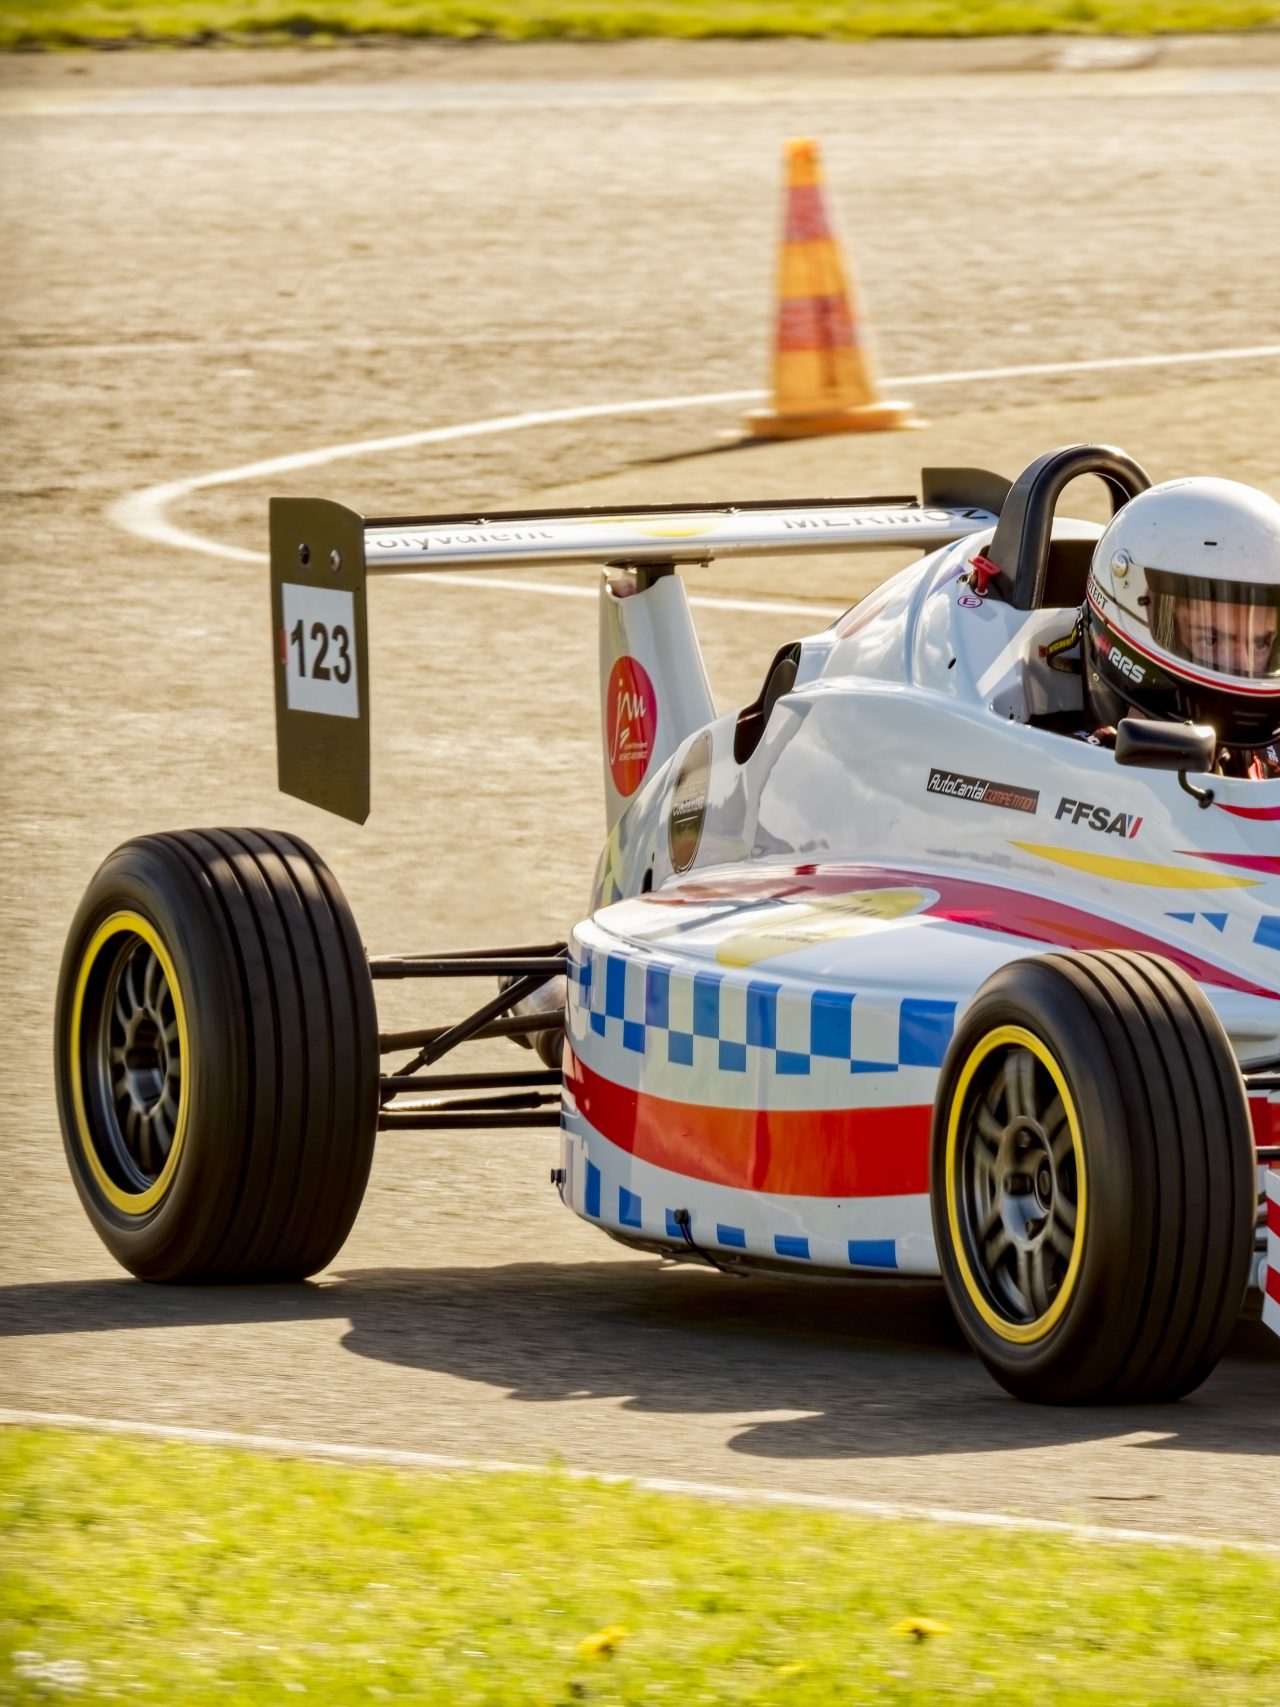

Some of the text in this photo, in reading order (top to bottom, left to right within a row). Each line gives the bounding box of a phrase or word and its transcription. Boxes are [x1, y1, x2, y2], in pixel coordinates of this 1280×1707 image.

[290, 618, 352, 685] 123
[1107, 646, 1147, 684] RRS
[928, 773, 990, 801] AutoCantal
[1054, 796, 1128, 839] FFSA
